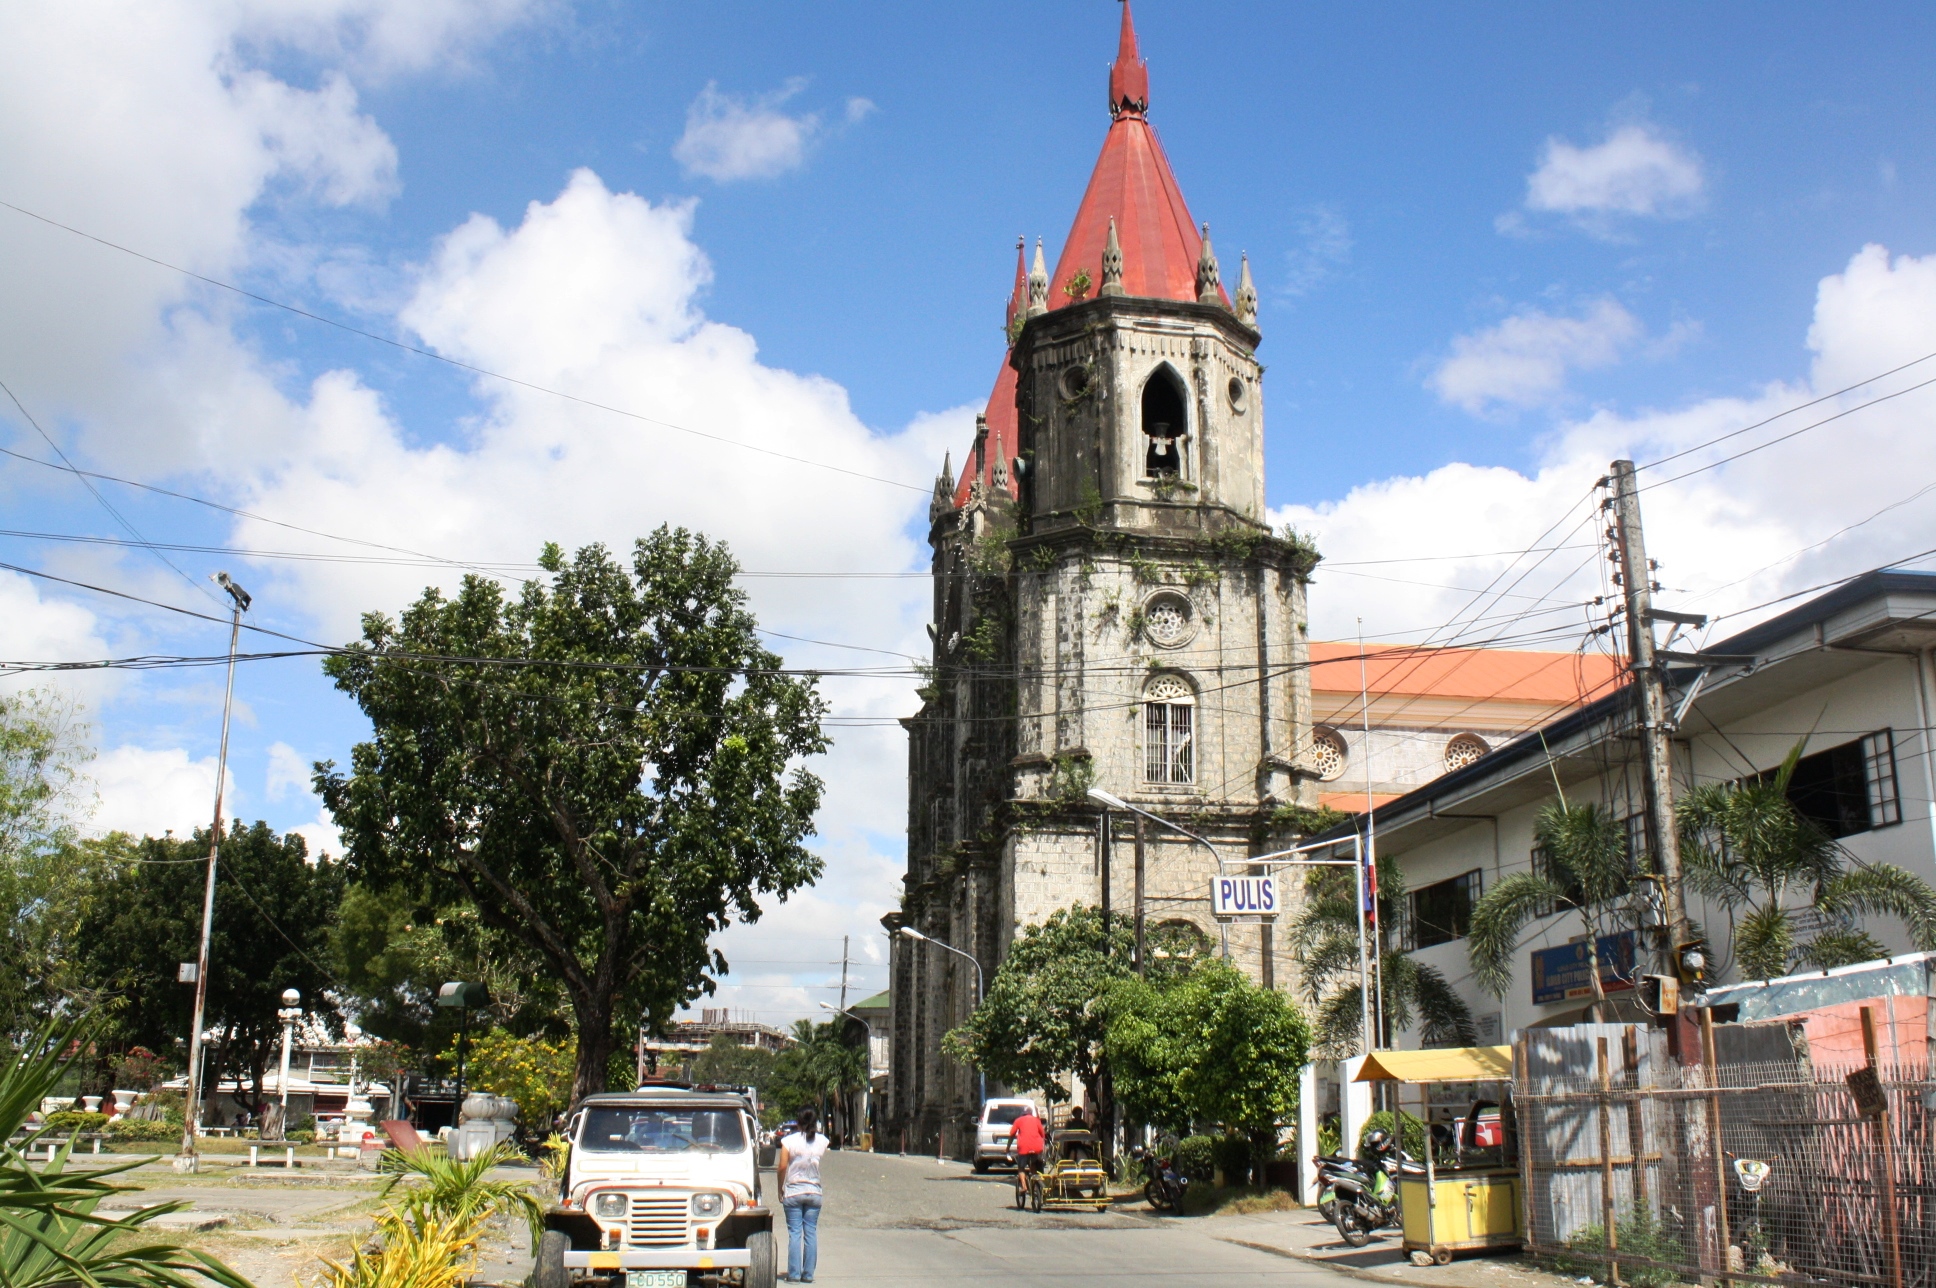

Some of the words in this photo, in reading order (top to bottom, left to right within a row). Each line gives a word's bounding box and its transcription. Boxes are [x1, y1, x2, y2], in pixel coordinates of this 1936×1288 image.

[1221, 879, 1273, 910] PULIS
[628, 1274, 654, 1287] LCD
[657, 1274, 684, 1287] 550
